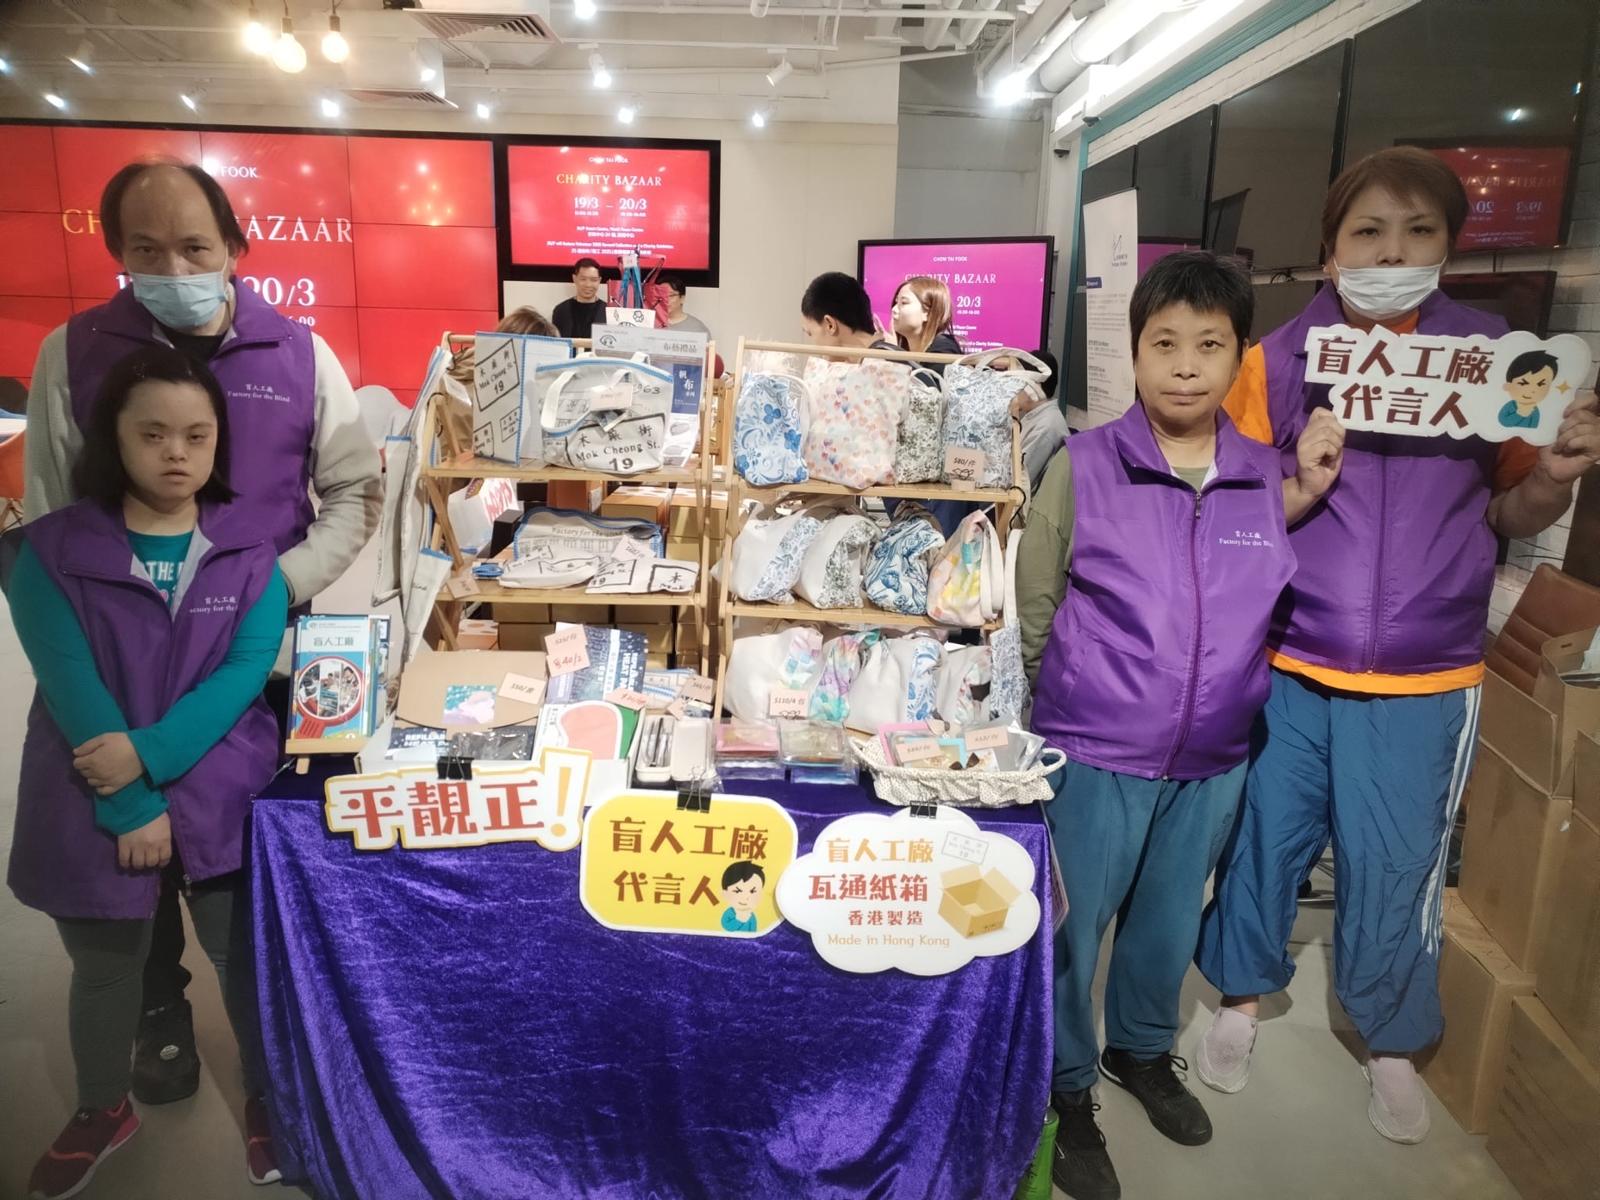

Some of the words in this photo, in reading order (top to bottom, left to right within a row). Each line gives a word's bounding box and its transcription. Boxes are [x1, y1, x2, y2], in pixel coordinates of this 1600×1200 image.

[221, 167, 257, 178] FOOK
[615, 175, 662, 187] BAZAAR
[619, 198, 647, 210] 20/3
[235, 214, 353, 243] AZAAR
[954, 273, 997, 284] BAZAAR
[957, 296, 981, 308] 20/3
[1317, 335, 1495, 386] 盲人工廠
[494, 380, 505, 394] 19
[1340, 381, 1470, 430] 代言人
[575, 450, 599, 461] Mok
[603, 443, 643, 453] Cheong
[646, 440, 661, 450] St.
[609, 458, 634, 472] 19
[146, 561, 174, 581] THE
[313, 637, 354, 647] 盲人工廠
[340, 766, 573, 838] 平靚正!
[609, 816, 768, 860] 盲人工廠
[826, 837, 934, 864] 盲人工廠
[613, 869, 720, 906] 代言人
[808, 873, 928, 902] 瓦通紙箱
[848, 910, 923, 926] 香港製造
[828, 935, 861, 946] Made
[867, 935, 878, 946] in
[883, 935, 914, 948] Hong
[919, 935, 950, 948] Kong
